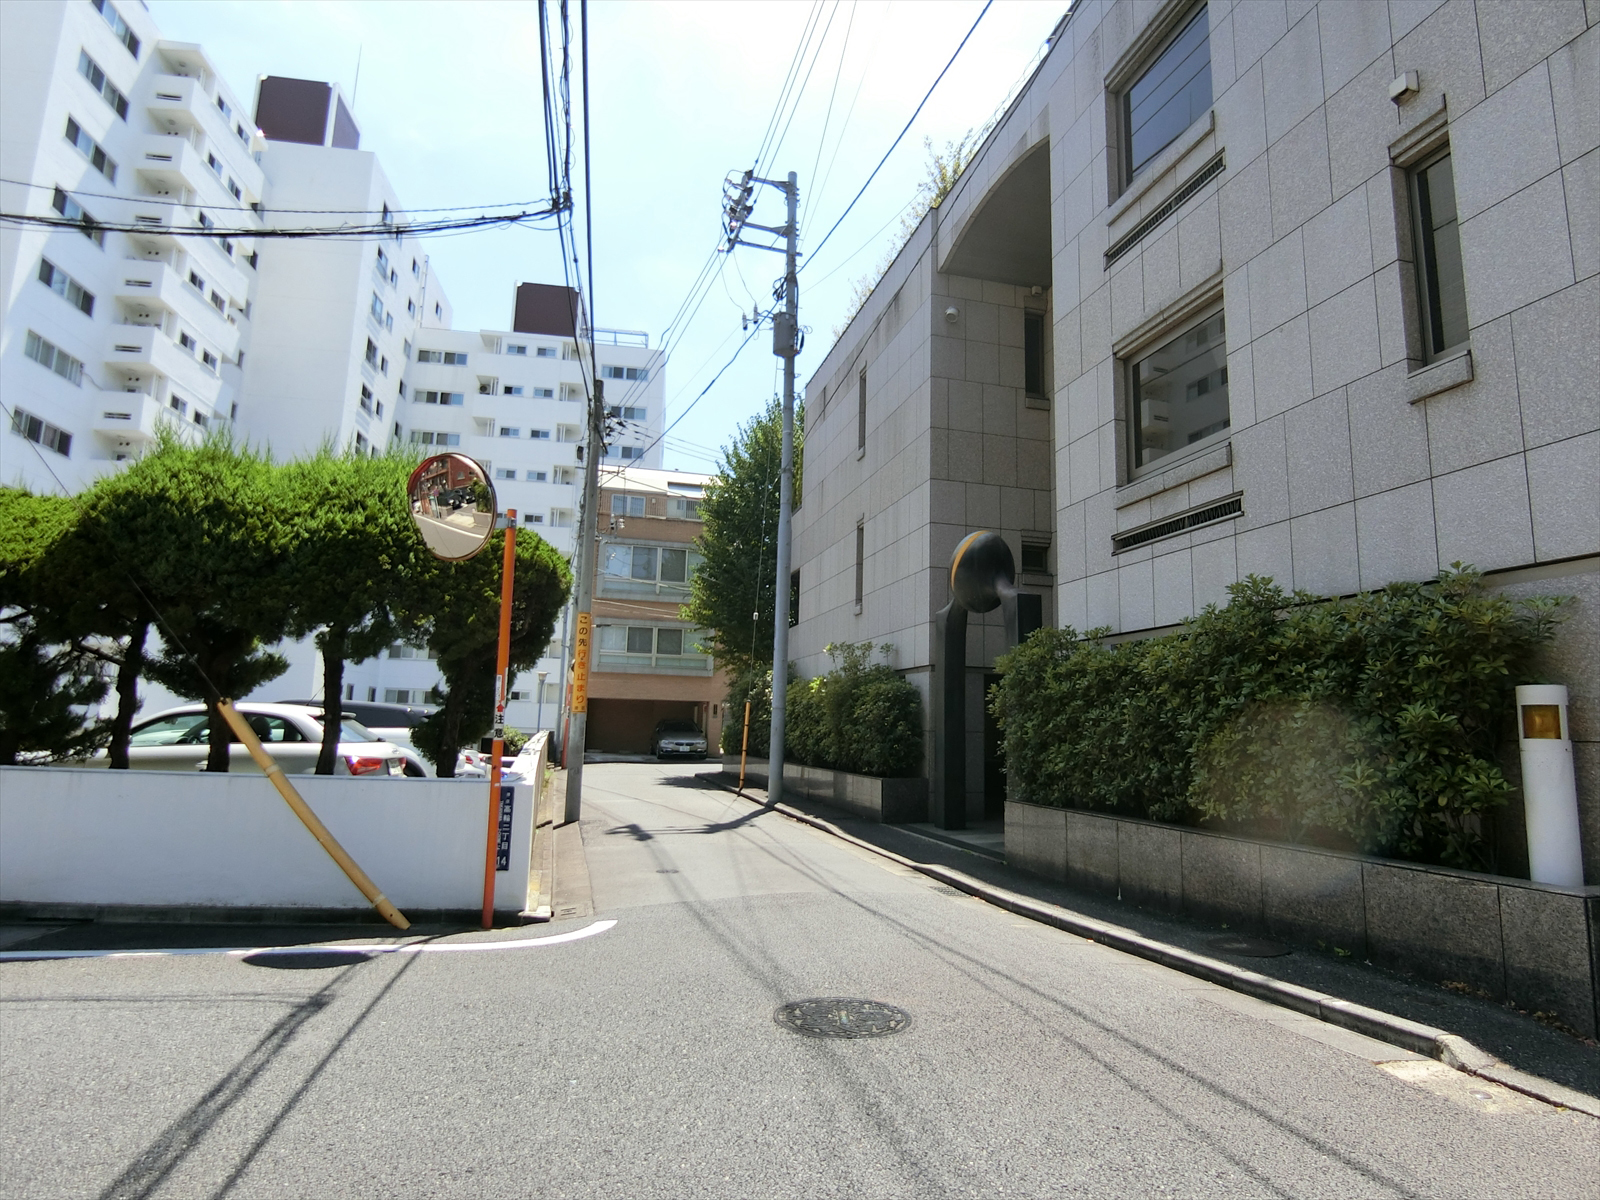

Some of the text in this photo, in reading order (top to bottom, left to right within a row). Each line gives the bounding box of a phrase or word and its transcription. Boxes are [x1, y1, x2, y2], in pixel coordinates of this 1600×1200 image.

[576, 615, 588, 704] この先行き止まり
[494, 714, 504, 738] 注意
[496, 856, 507, 866] 14
